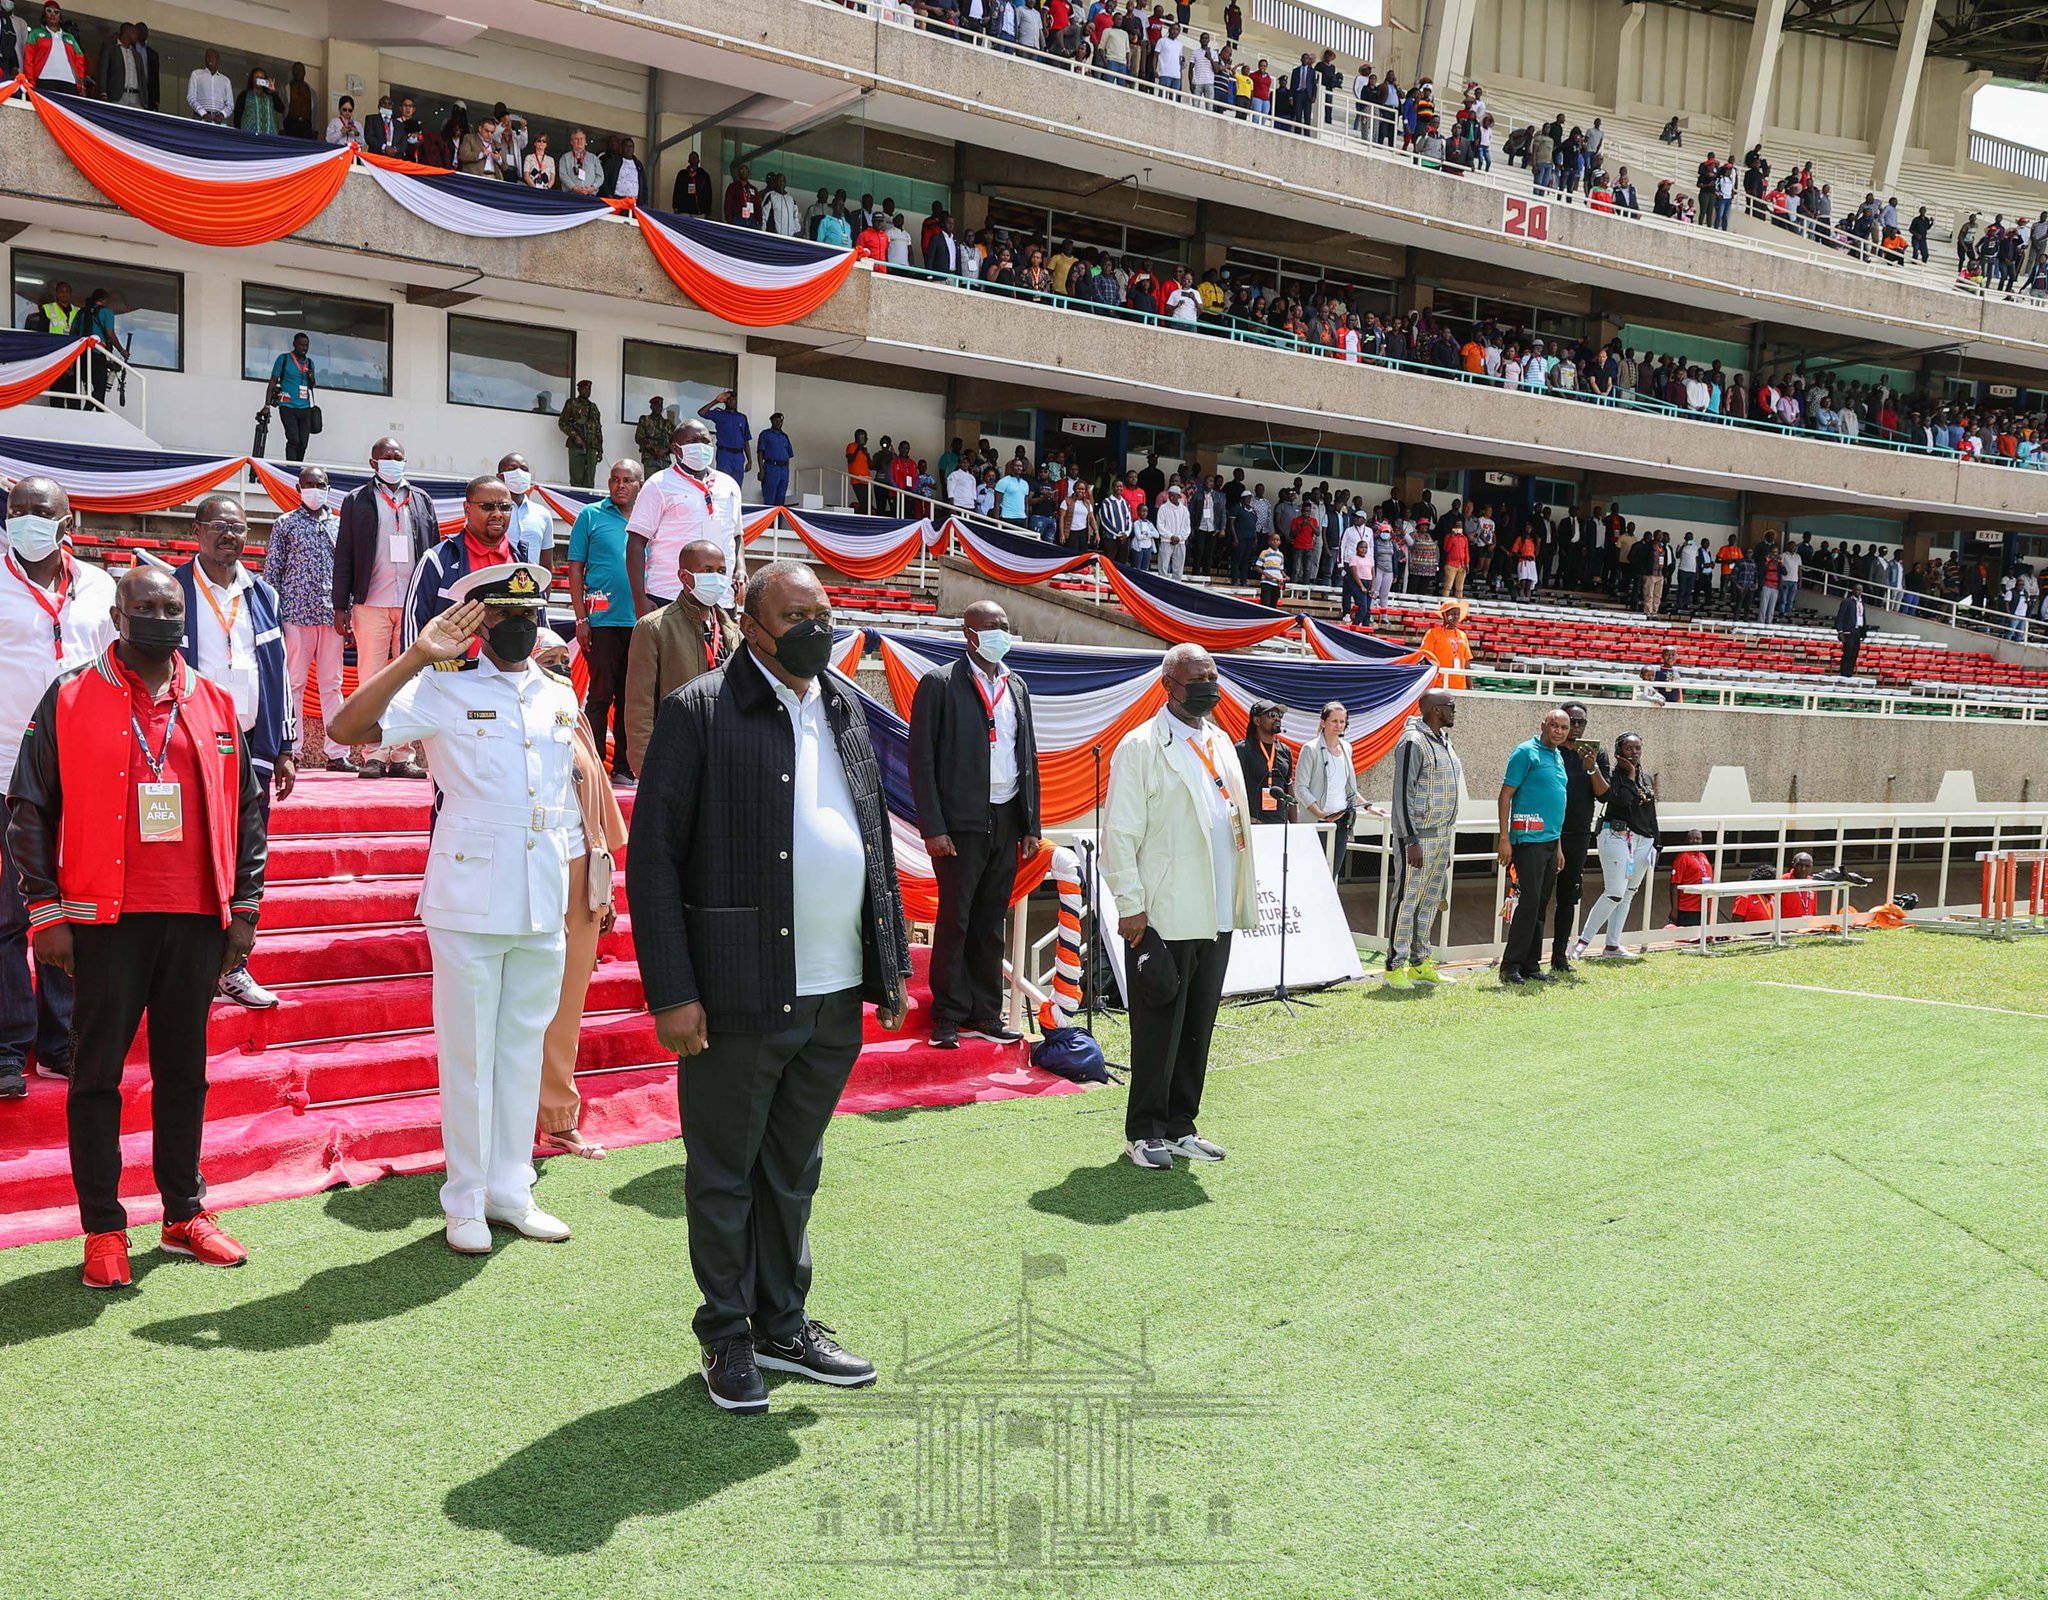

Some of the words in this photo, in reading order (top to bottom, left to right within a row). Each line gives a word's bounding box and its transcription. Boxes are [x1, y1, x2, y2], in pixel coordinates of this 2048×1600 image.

[1505, 197, 1547, 240] 20
[1993, 387, 2014, 395] EXIT
[1072, 422, 1097, 433] EXIT
[1979, 532, 2001, 540] EXIT
[150, 802, 171, 811] ALL
[146, 811, 176, 820] AREA
[1256, 891, 1281, 905] RTS,
[1258, 907, 1290, 921] TURE
[1292, 906, 1302, 918] &
